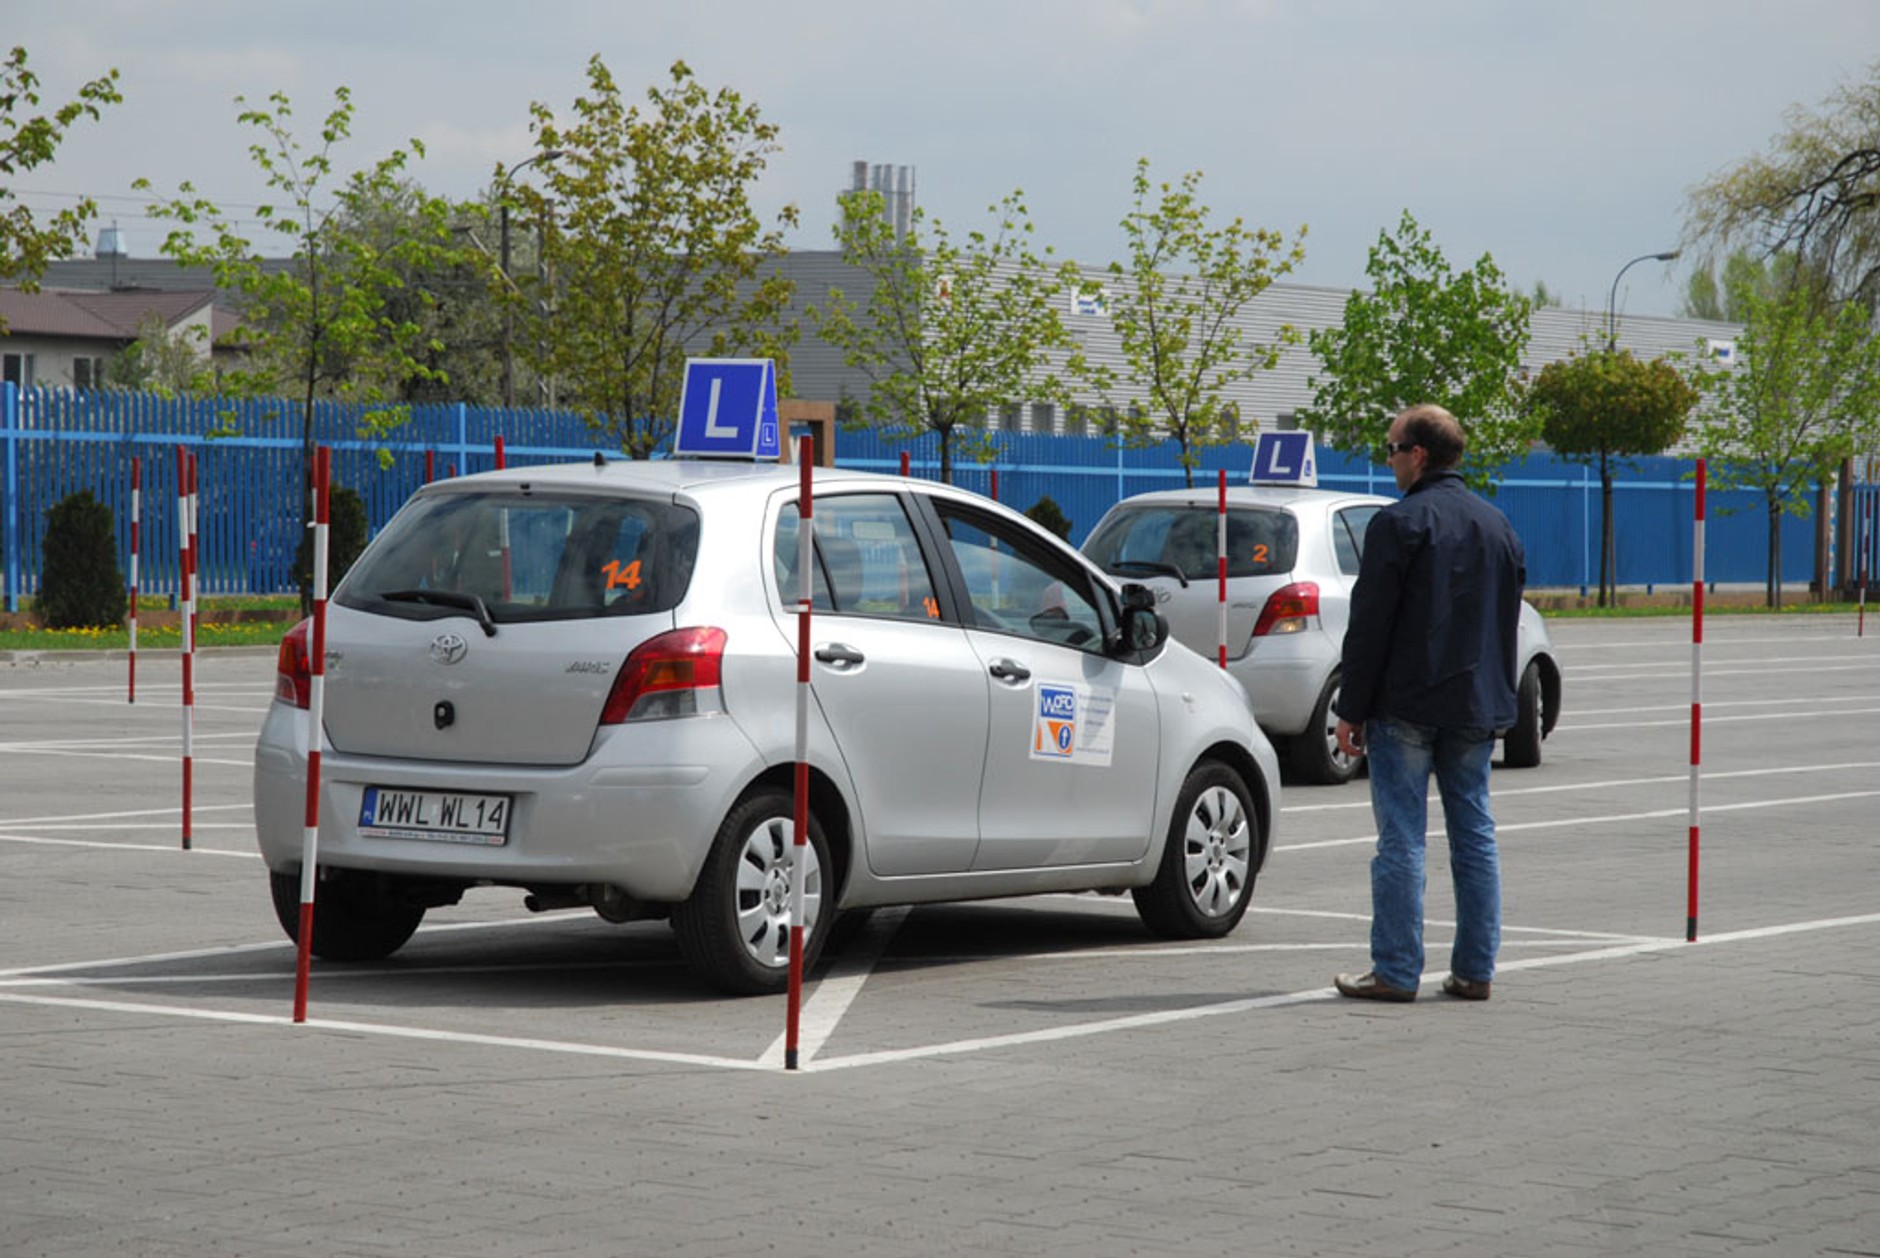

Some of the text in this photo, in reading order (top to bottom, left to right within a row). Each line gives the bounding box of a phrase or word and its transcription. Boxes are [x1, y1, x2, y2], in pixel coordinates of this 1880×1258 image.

[705, 378, 739, 438] L
[765, 426, 772, 442] L
[1269, 440, 1291, 474] L
[1252, 543, 1269, 562] 2
[602, 560, 642, 590] 14
[379, 793, 505, 830] WWL WL14
